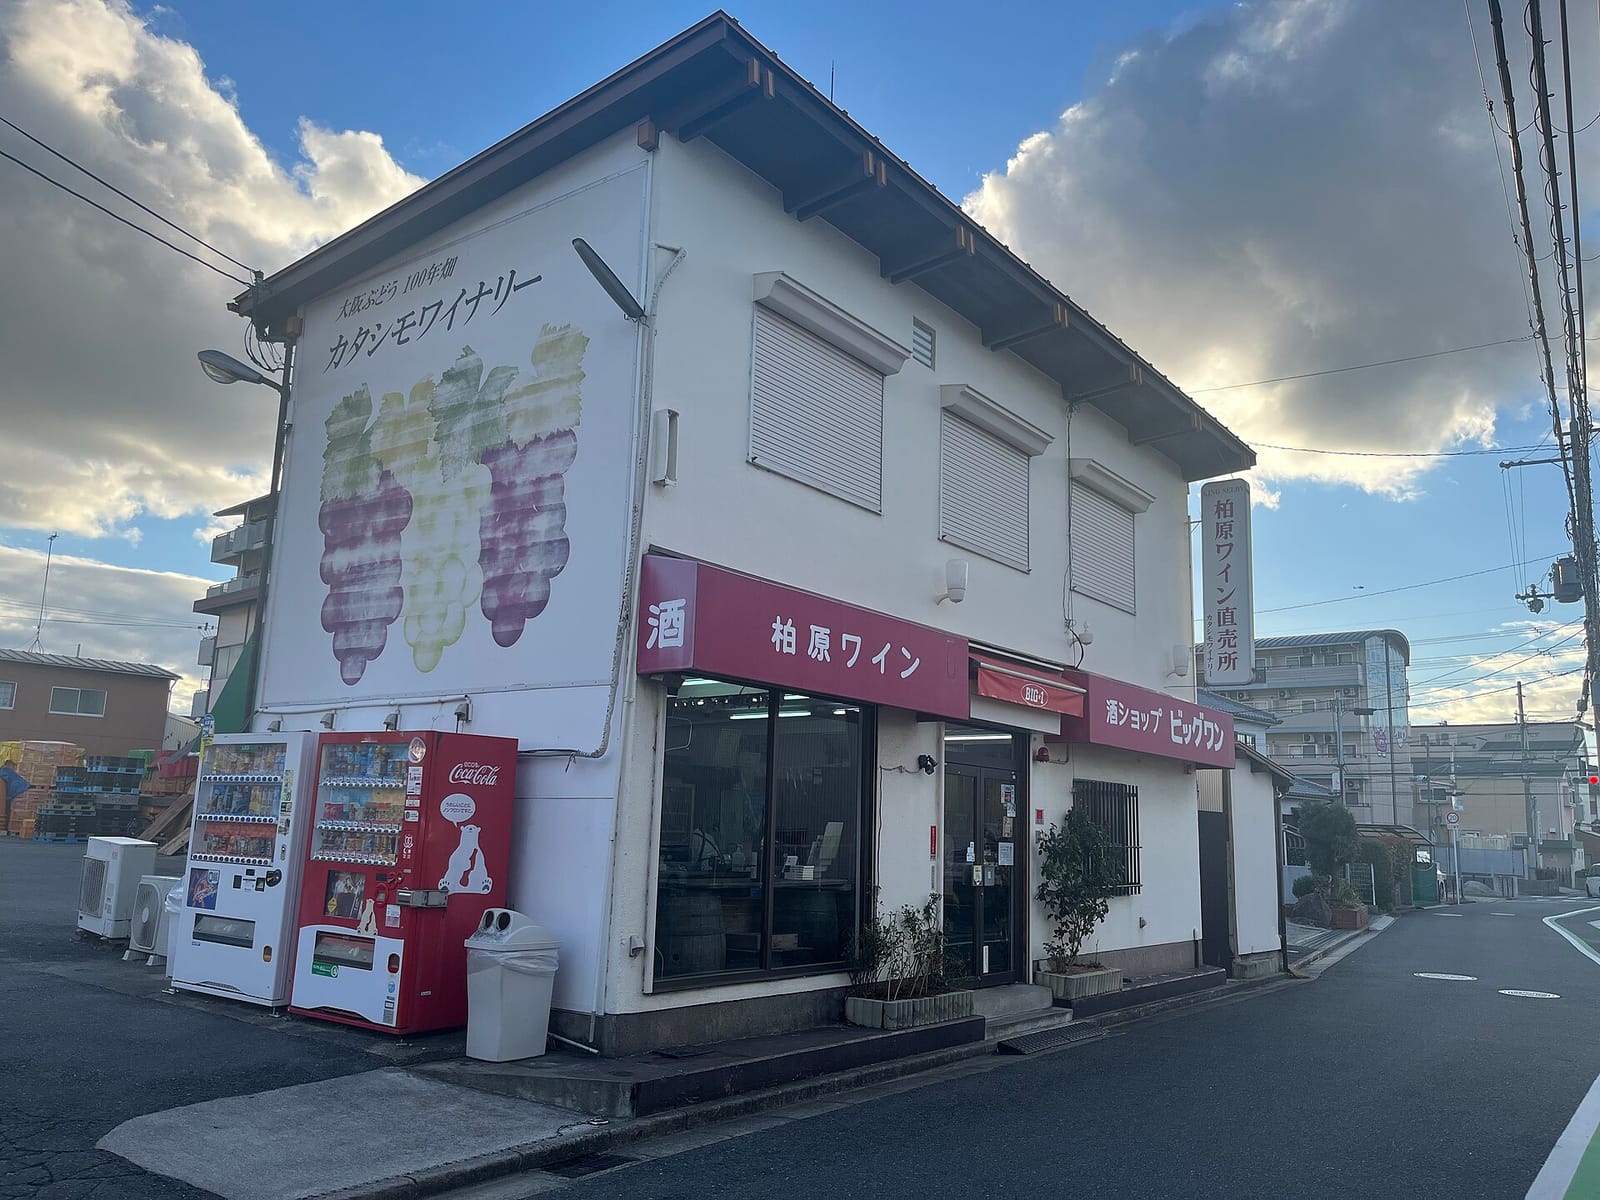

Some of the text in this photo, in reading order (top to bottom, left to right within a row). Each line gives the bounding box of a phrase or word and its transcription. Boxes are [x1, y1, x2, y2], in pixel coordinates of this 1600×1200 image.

[336, 256, 458, 322] 大阪ぶどう 100年畑
[322, 269, 543, 375] カタシモワイナリー
[1214, 499, 1237, 672] 柏原ワイン直売所
[646, 598, 687, 649] 酒
[771, 615, 921, 679] 柏原ワイン
[1206, 614, 1214, 678] カタシモワイナリー
[1106, 699, 1224, 752] 酒ショップ ビッグワン
[449, 763, 501, 786] Coca-Cola
